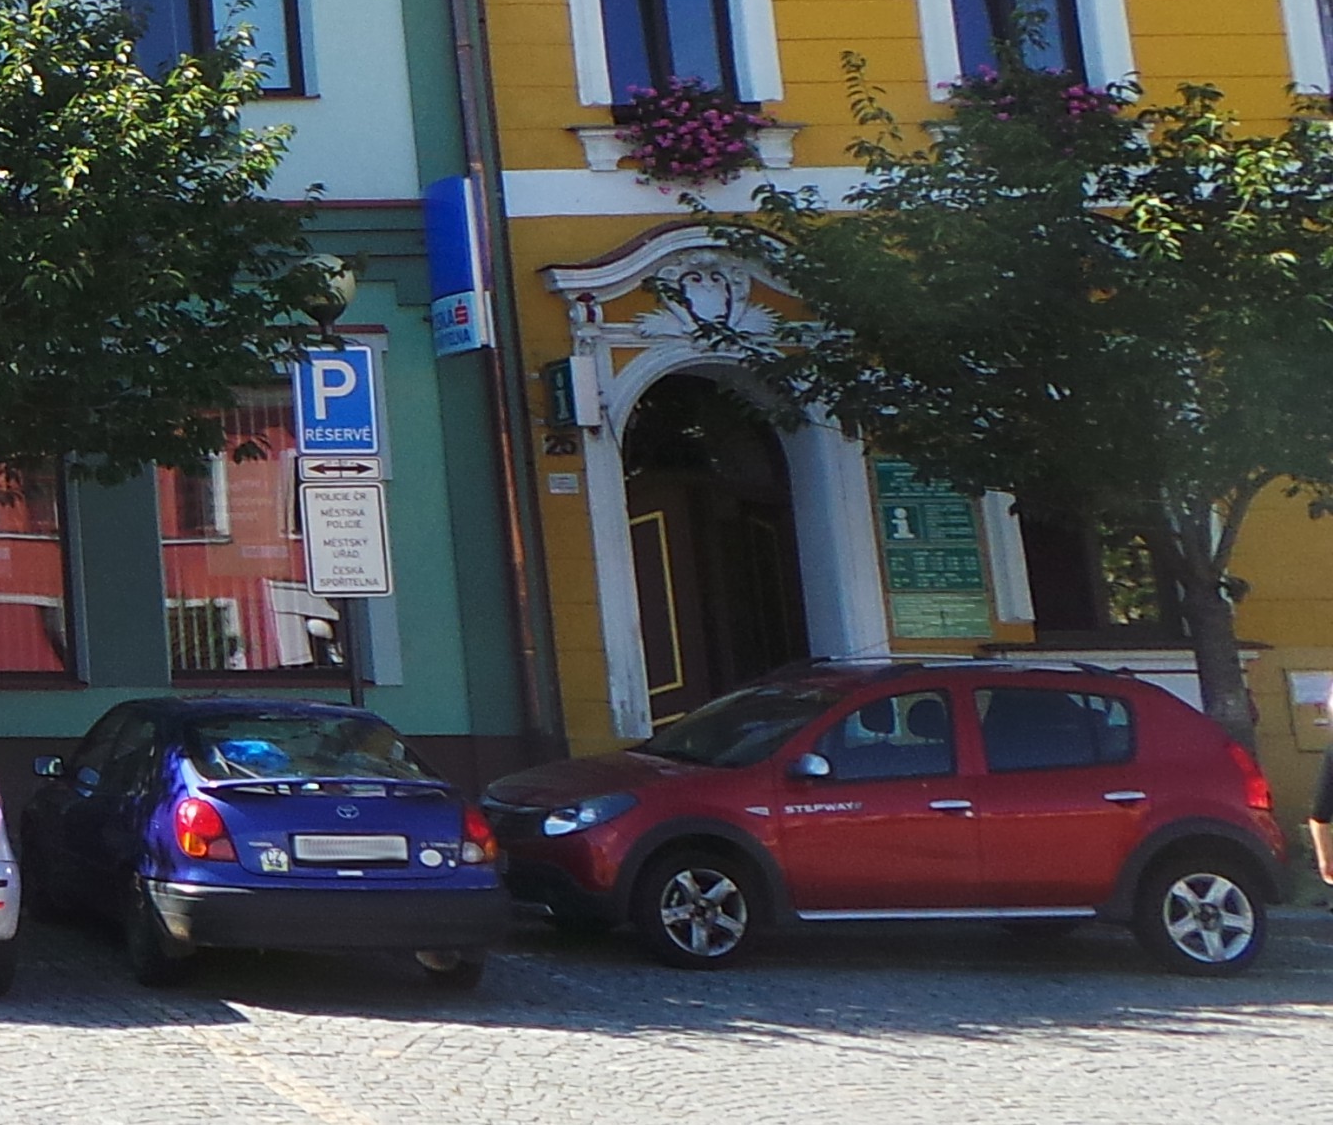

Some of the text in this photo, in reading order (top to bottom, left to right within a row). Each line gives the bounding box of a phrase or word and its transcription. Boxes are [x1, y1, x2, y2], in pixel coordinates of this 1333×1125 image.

[312, 359, 357, 421] P
[315, 492, 351, 501] POLICIE
[326, 519, 363, 529] POLICIE
[784, 801, 854, 814] STEPWAY
